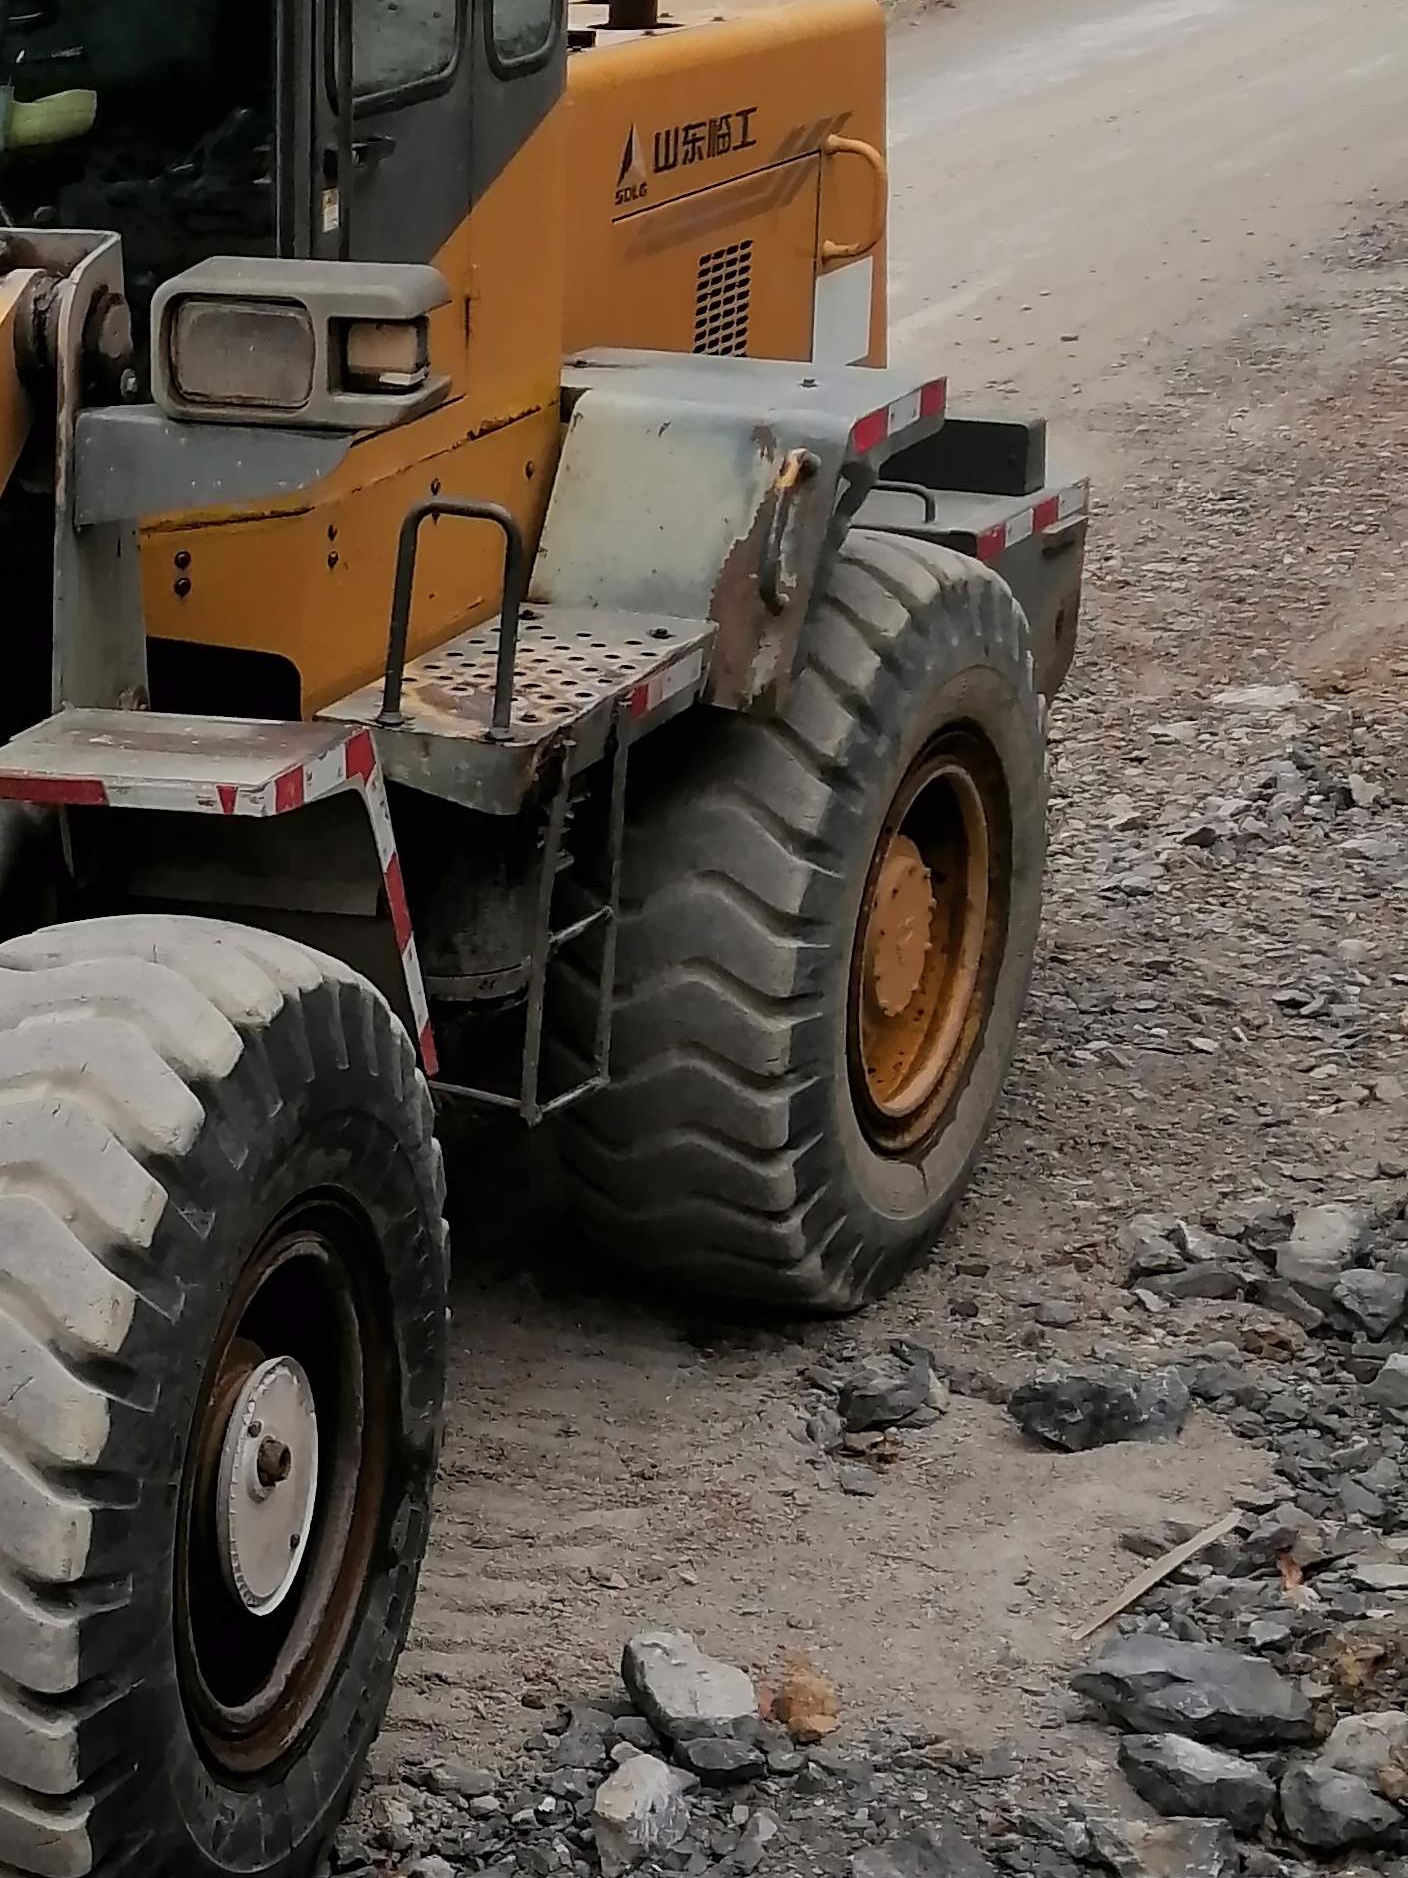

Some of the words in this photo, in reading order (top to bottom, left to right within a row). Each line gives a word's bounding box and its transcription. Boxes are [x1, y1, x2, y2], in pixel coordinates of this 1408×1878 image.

[653, 106, 757, 173] 山东临工
[615, 181, 647, 205] SDLG
